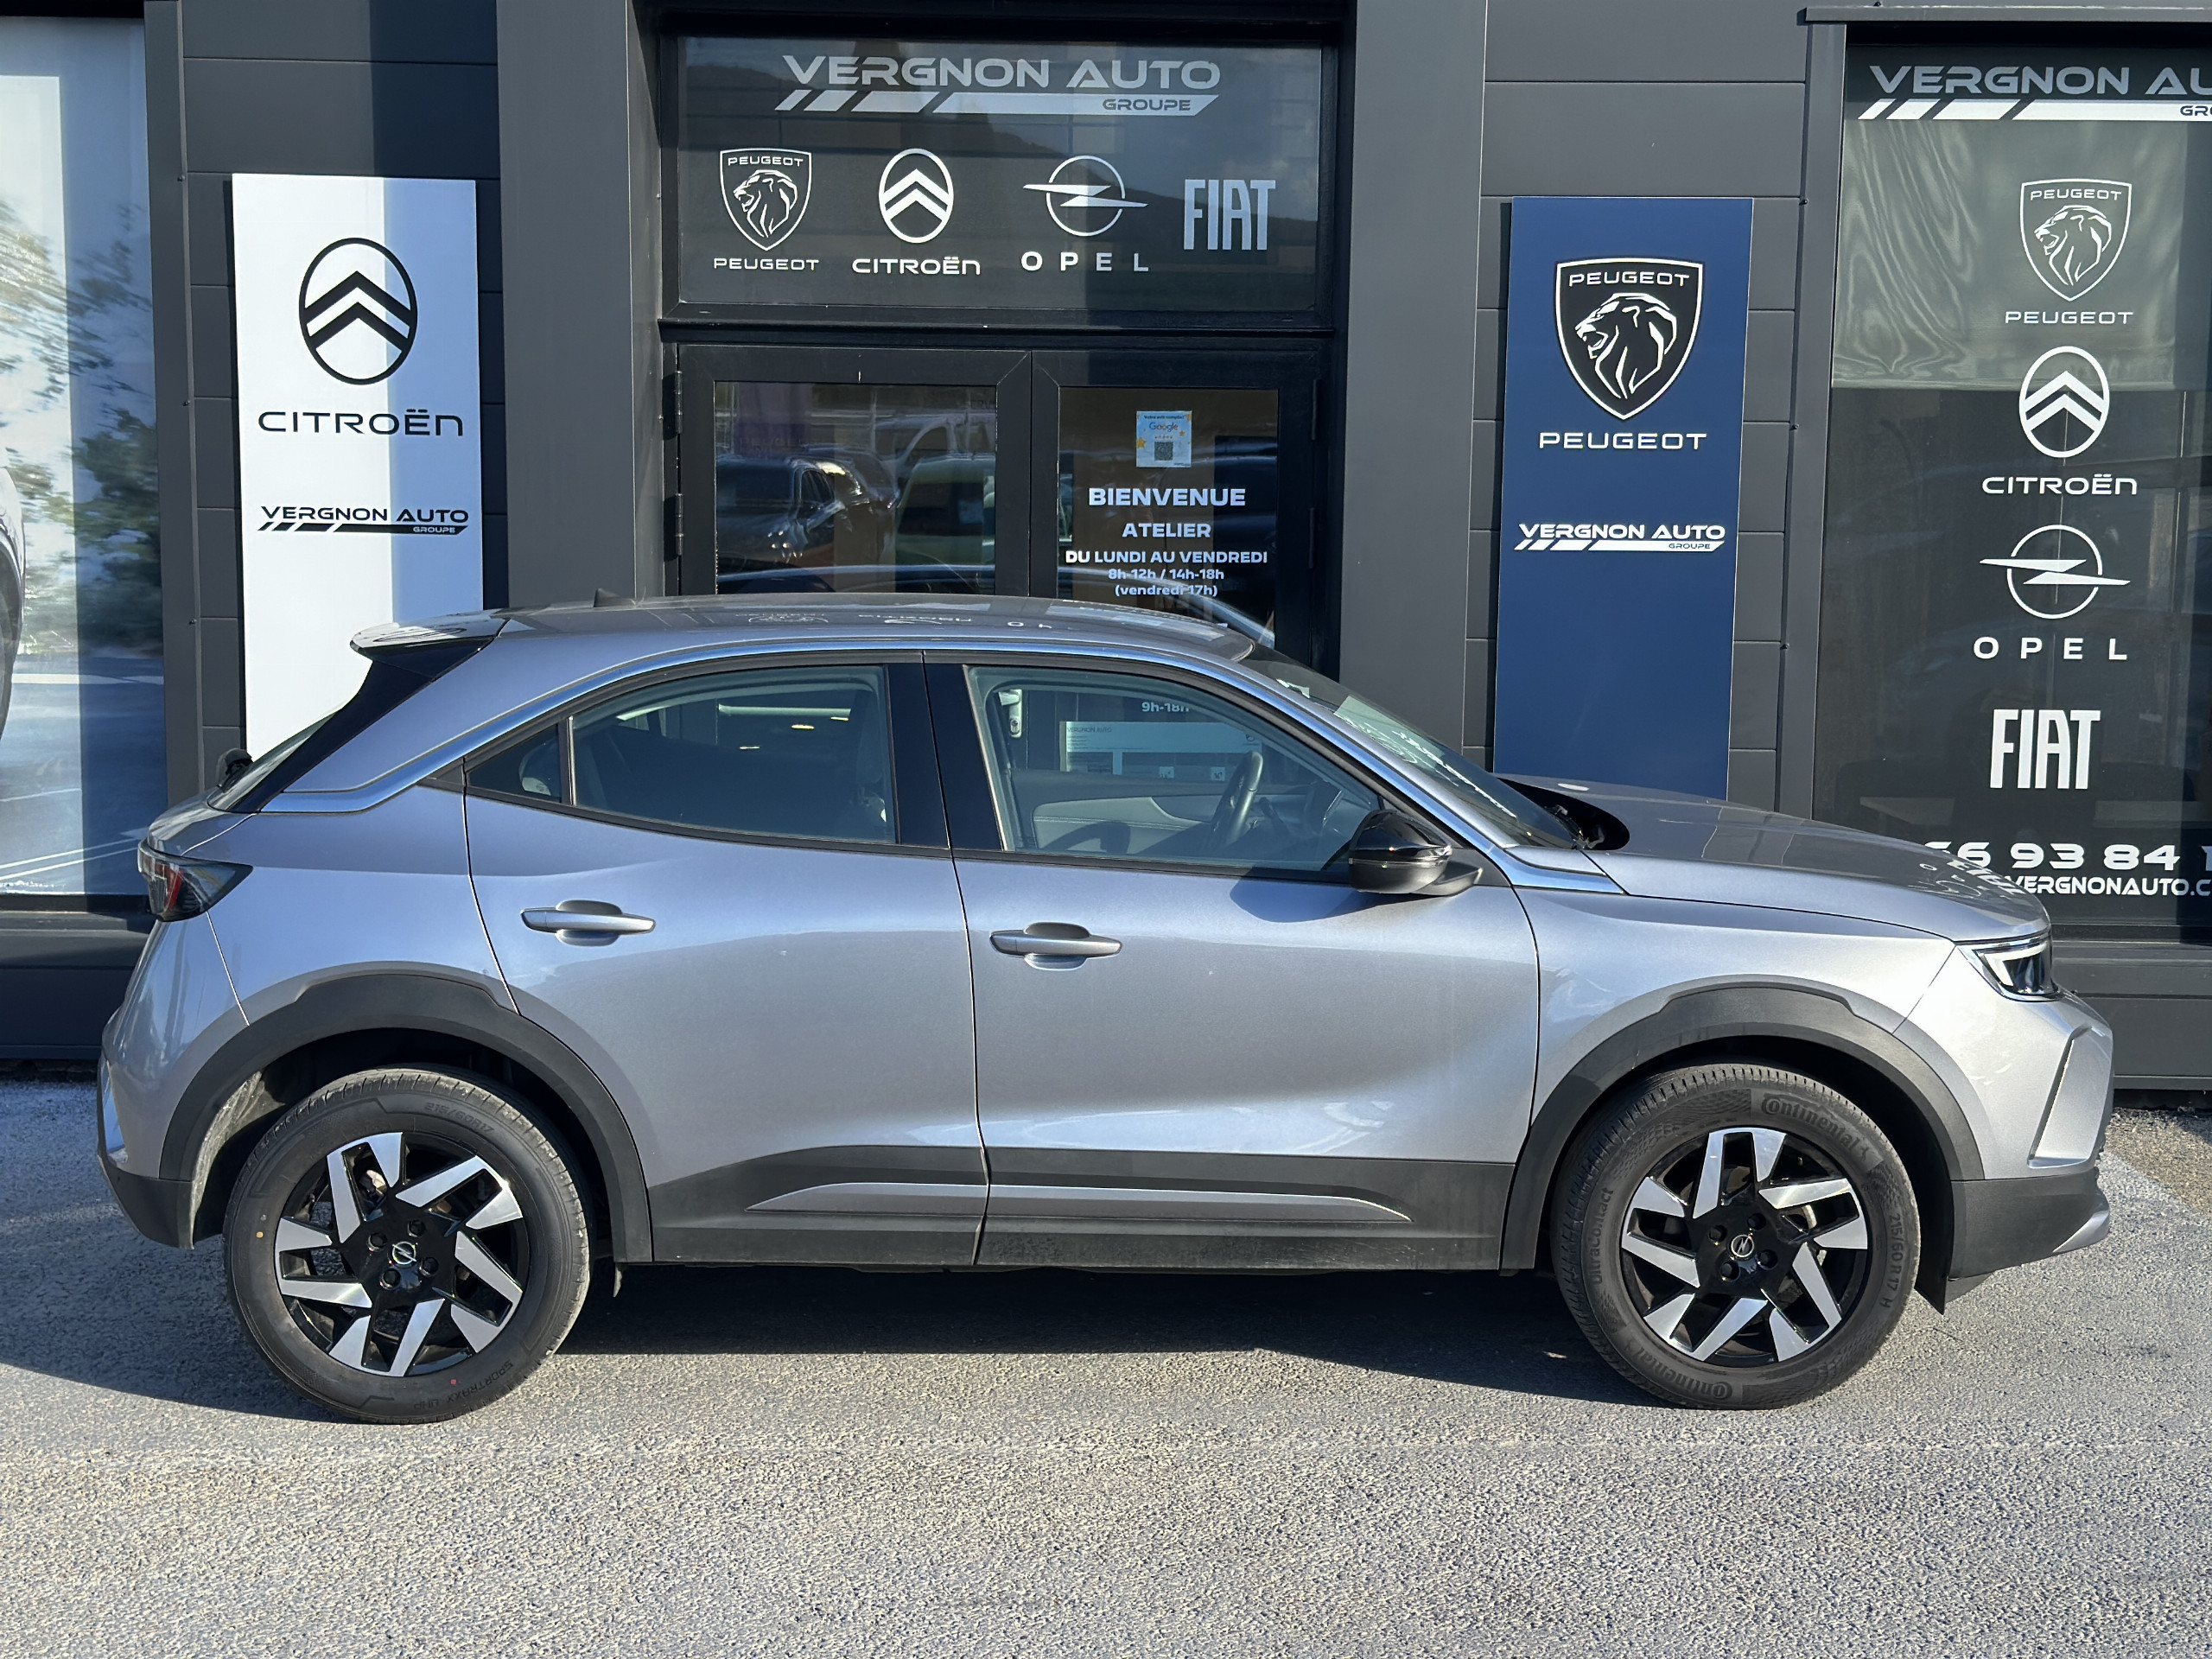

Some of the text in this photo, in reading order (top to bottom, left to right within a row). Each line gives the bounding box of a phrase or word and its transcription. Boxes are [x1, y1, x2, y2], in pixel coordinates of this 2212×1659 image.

[782, 54, 1221, 89] VERGNON AUTO
[1869, 66, 2212, 96] VERGNON AU
[1102, 97, 1192, 112] GROUPE
[2180, 105, 2212, 117] GR
[727, 154, 804, 168] PEUGEOT
[2030, 188, 2123, 202] PEUGEOT
[1184, 179, 1276, 251] FIAT
[714, 257, 820, 271] PEUGEOT
[1020, 251, 1149, 273] OPEL
[1568, 270, 1691, 287] PEUGEOT
[2005, 311, 2134, 325] PEUGEOT
[1149, 422, 1179, 433] Google
[1539, 432, 1707, 450] PEUGEOT
[1089, 487, 1246, 506] BIENVENUE
[261, 505, 469, 524] VERGNON AUTO
[412, 525, 456, 534] GROUPE
[1122, 523, 1211, 537] ATELIER
[1518, 524, 1726, 540] VERGNON AUTO
[1668, 542, 1712, 550] GROUPE
[1065, 550, 1268, 563] DU LUNDI AU VENDREDI
[1108, 569, 1156, 580] 8h-12h
[1169, 569, 1224, 580] 14h-18h
[1115, 584, 1218, 596] (vendredi 17h)
[1973, 636, 2127, 660] OPEL
[1990, 709, 2101, 790] FIAT
[2010, 842, 2085, 869] 93
[2103, 843, 2181, 872] 84
[1760, 1096, 1859, 1152] Continental
[1889, 1212, 1904, 1262] 215/60
